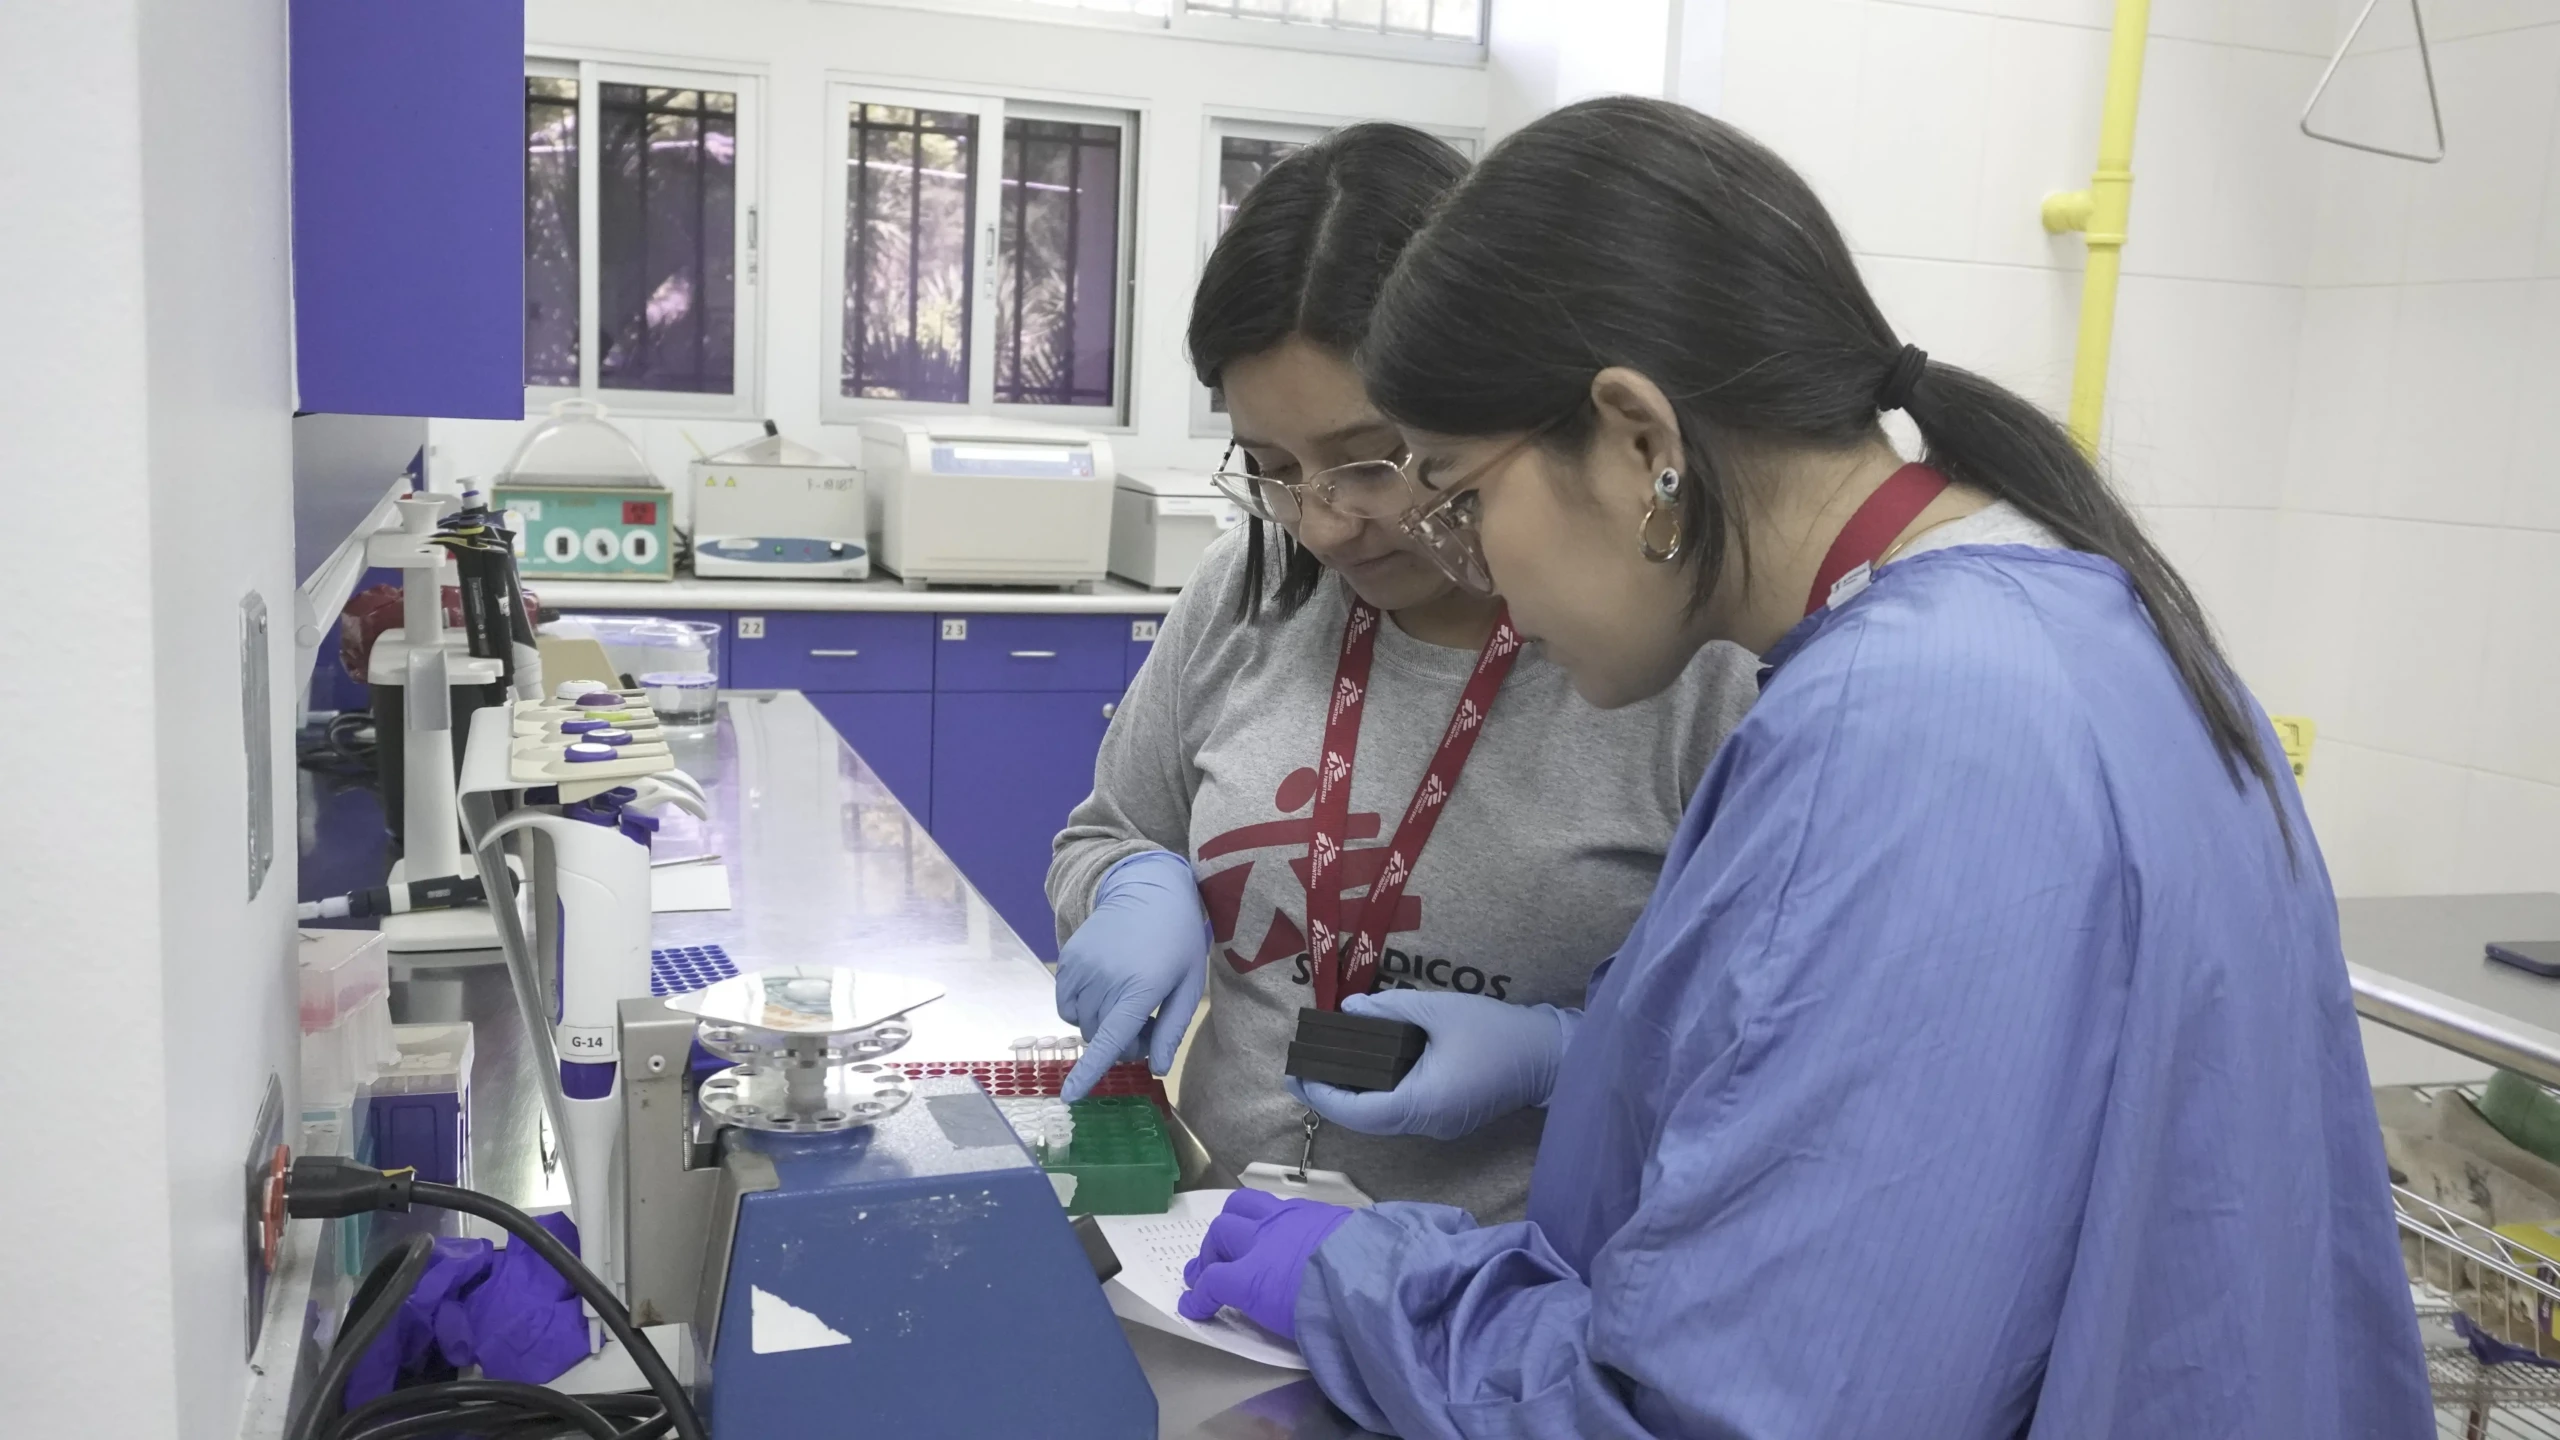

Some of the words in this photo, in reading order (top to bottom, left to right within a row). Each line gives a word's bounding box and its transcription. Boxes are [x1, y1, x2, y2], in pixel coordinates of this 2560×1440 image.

[945, 624, 964, 636] 23
[1135, 626, 1153, 637] 24
[1340, 934, 1511, 1000] DICOS
[572, 1036, 603, 1048] G-14
